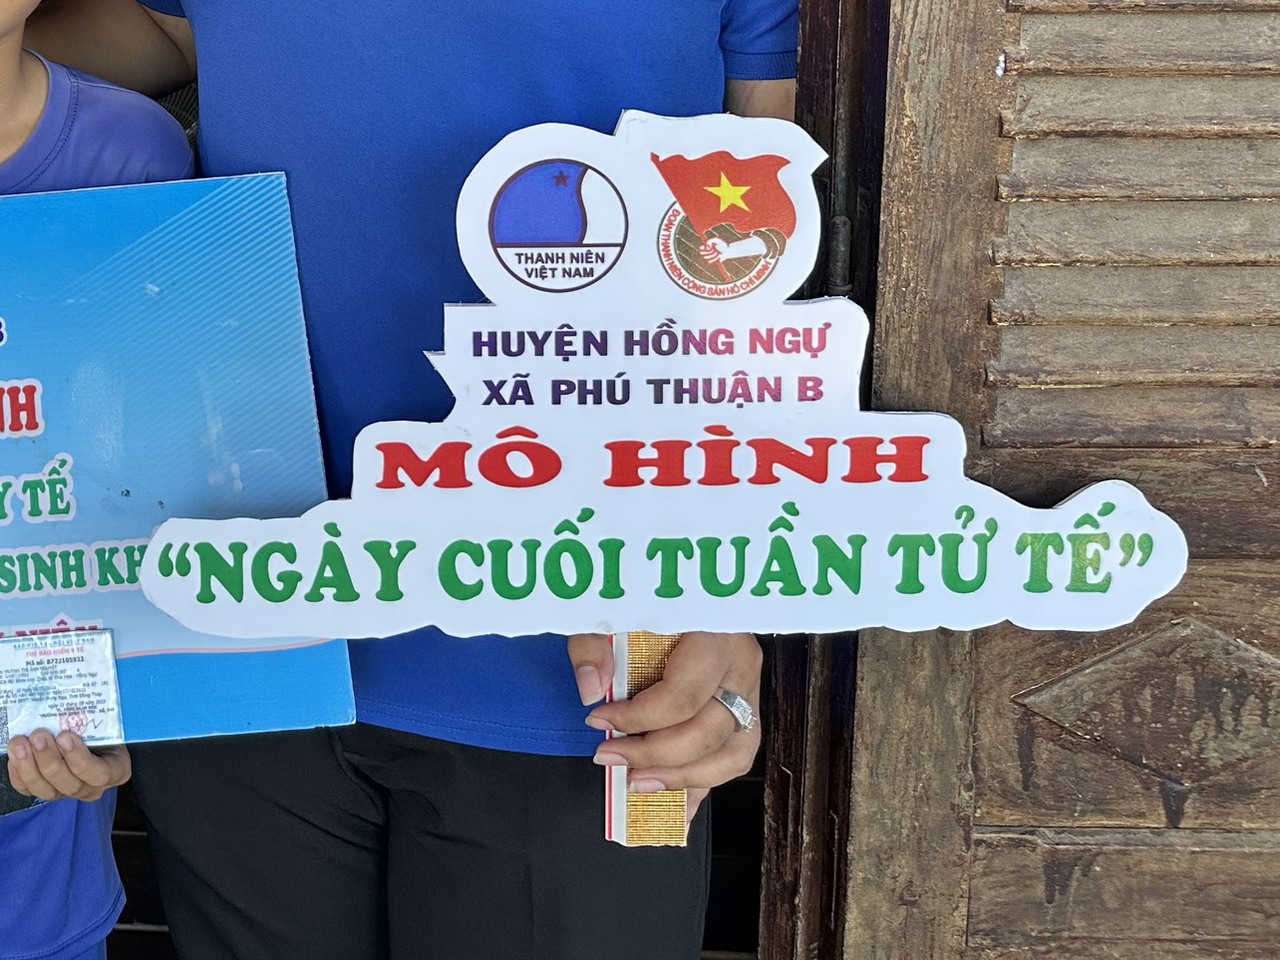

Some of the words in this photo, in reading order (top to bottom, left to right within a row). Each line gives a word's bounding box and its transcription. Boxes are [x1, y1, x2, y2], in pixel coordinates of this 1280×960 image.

[515, 252, 567, 264] THANH
[570, 249, 605, 264] NIÊN
[524, 264, 558, 280] VIỆT
[562, 267, 594, 279] NAM
[661, 229, 673, 261] THANH
[751, 261, 771, 284] MINH
[472, 324, 608, 361] HUYỆN
[625, 318, 734, 356] HỒNG
[750, 321, 831, 359] NGỰ
[482, 374, 535, 406] XÃ
[552, 372, 631, 406] PHÚ
[647, 370, 782, 409] THUẬN
[798, 376, 824, 402] B
[375, 426, 563, 490] MÔ
[604, 424, 931, 488] HÌNH
[22, 459, 71, 516] TẾ
[437, 507, 626, 601] CUỐI
[646, 501, 868, 598] TUẦN
[887, 505, 998, 594] TỬ
